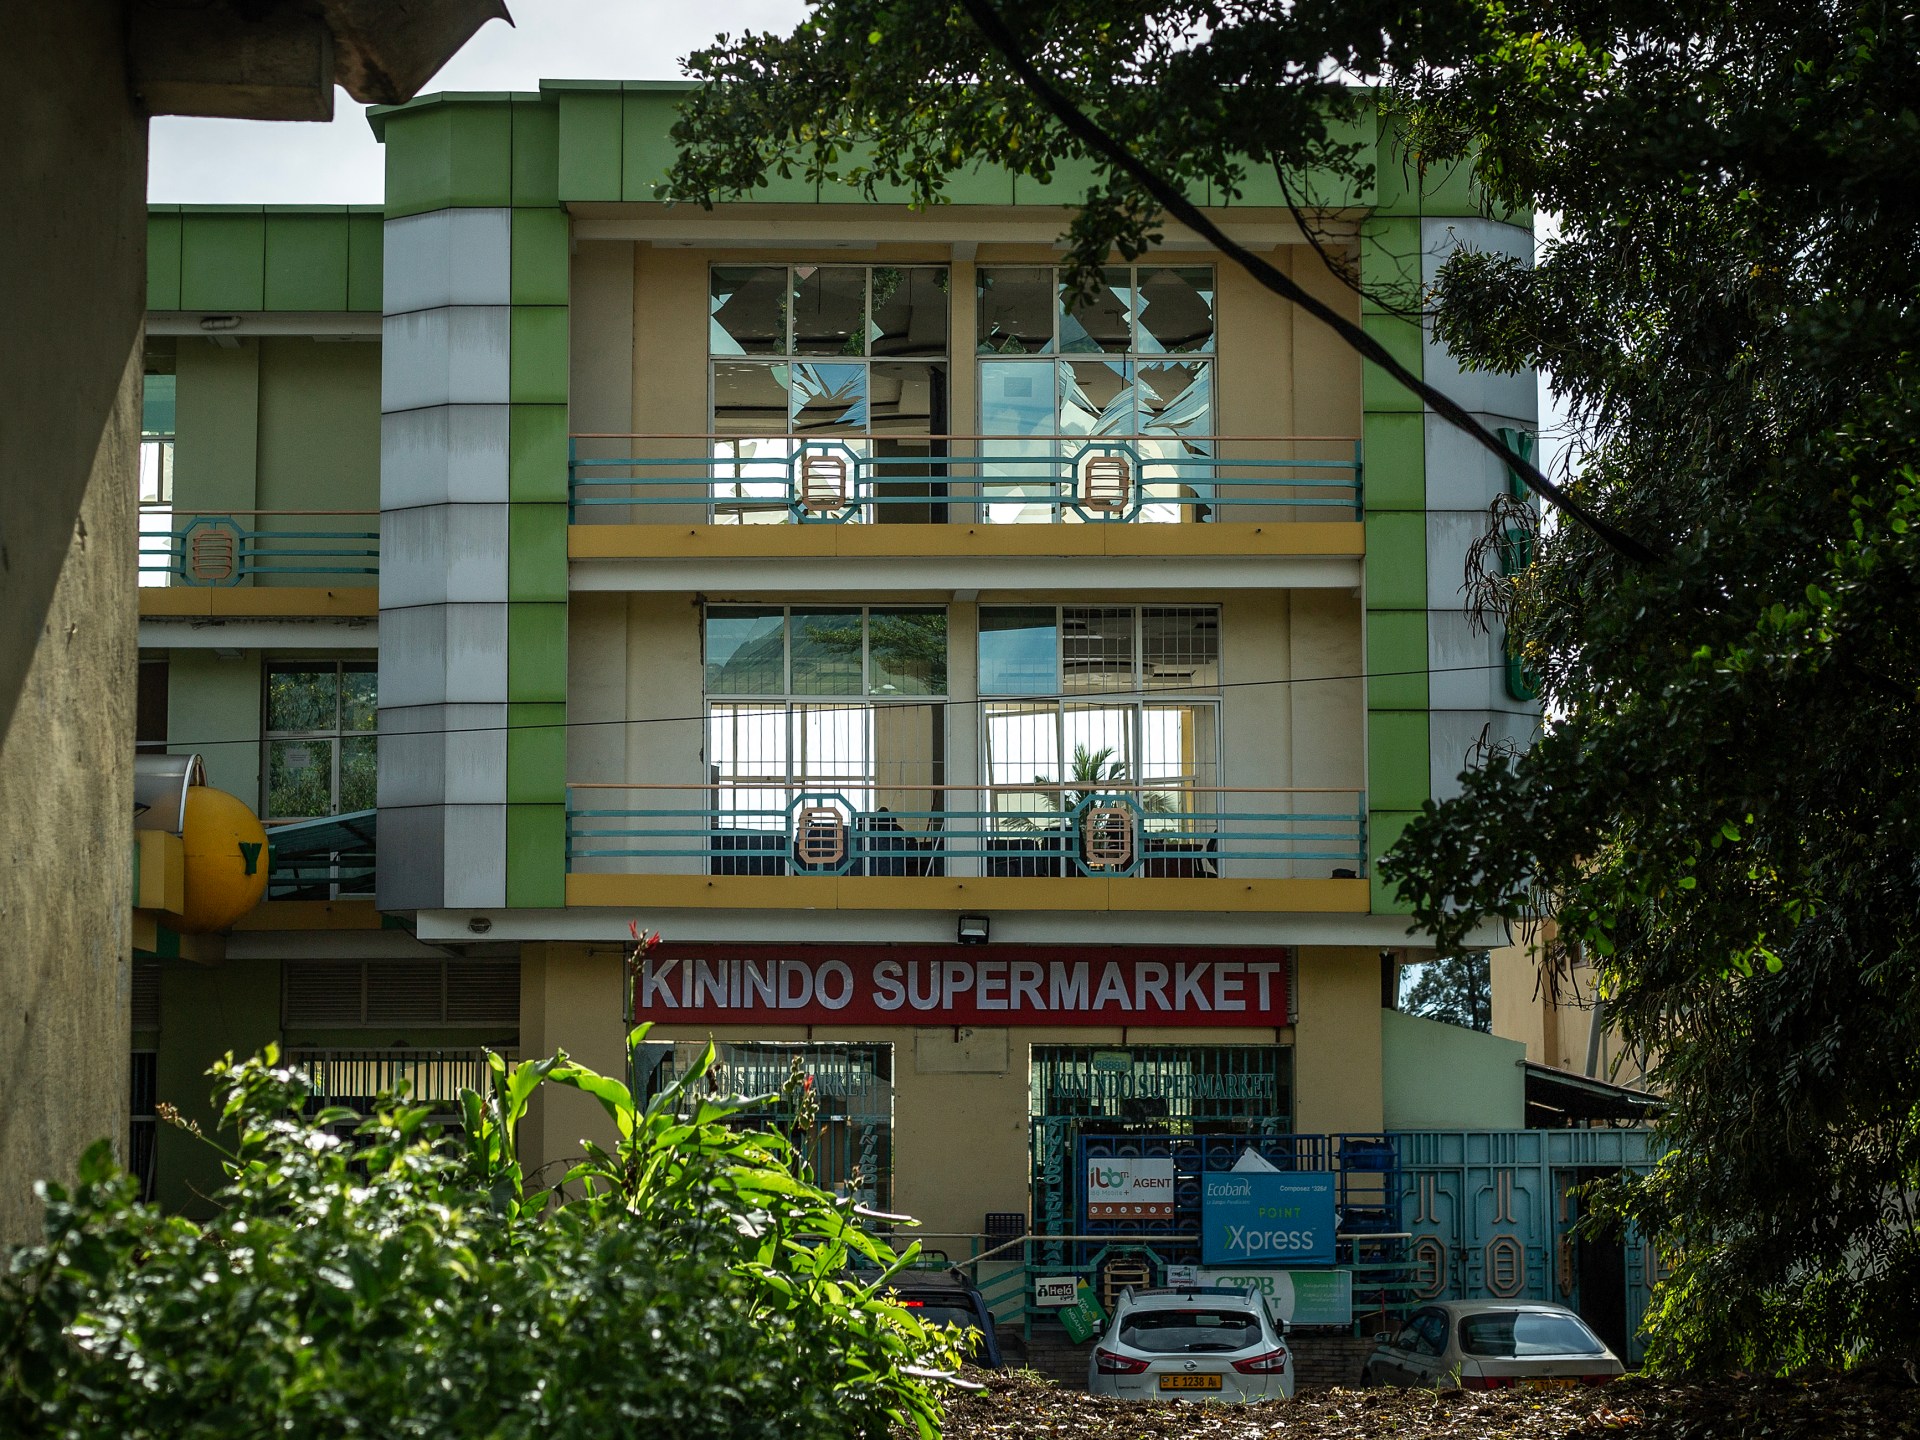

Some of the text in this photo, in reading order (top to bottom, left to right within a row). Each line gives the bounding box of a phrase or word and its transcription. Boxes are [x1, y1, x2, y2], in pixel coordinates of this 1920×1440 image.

[643, 959, 1280, 1012] KININDO SUPERMARKET
[1052, 1072, 1275, 1100] KININDO SUPERMARKET
[1133, 1178, 1172, 1188] AGENT
[1207, 1179, 1252, 1196] Ecobank
[1259, 1207, 1301, 1218] POINT
[1227, 1225, 1314, 1256] Xpress
[1049, 1284, 1072, 1295] Helá
[1182, 1377, 1204, 1387] 1238
